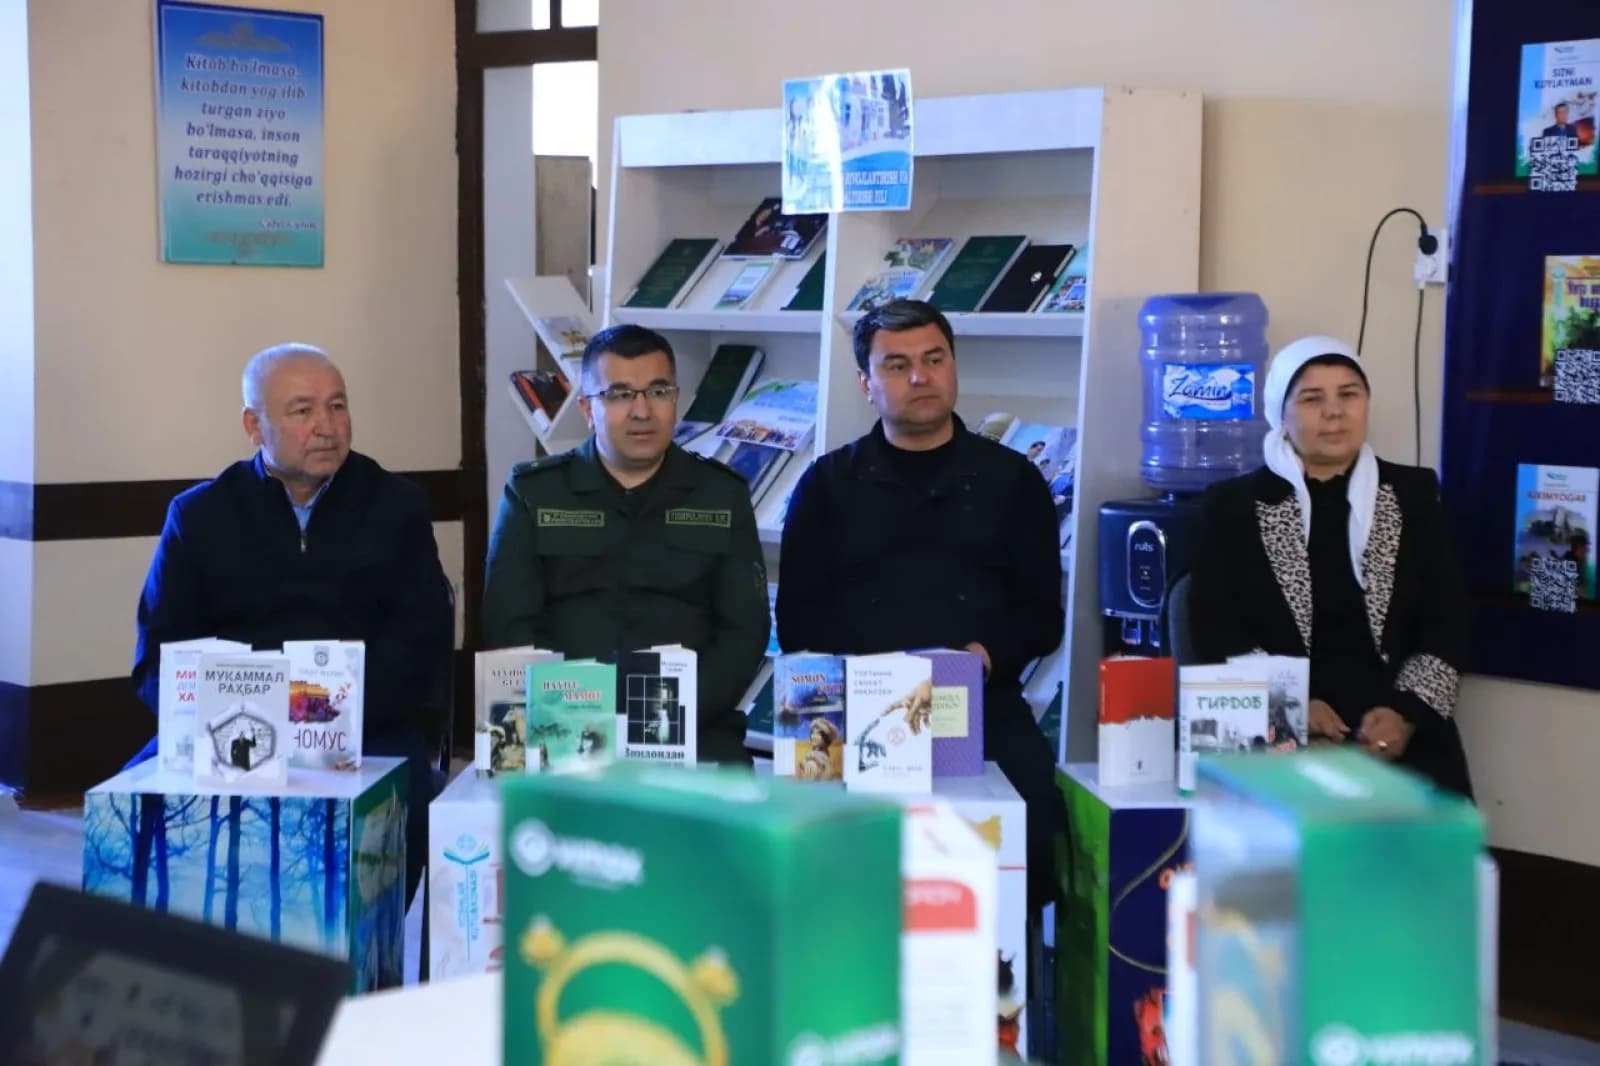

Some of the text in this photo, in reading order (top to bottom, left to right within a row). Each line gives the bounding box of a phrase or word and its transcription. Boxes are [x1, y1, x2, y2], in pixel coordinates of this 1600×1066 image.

[186, 55, 227, 71] Kitob
[181, 78, 247, 95] kitobdan
[201, 103, 286, 123] turgan ziyo
[261, 127, 300, 142] inson
[188, 145, 299, 167] taraqqiyotning
[174, 165, 227, 185] hozirgi
[196, 190, 262, 206] erishmas
[1168, 374, 1232, 400] Zamin
[205, 670, 285, 683] МУКАММАЛ
